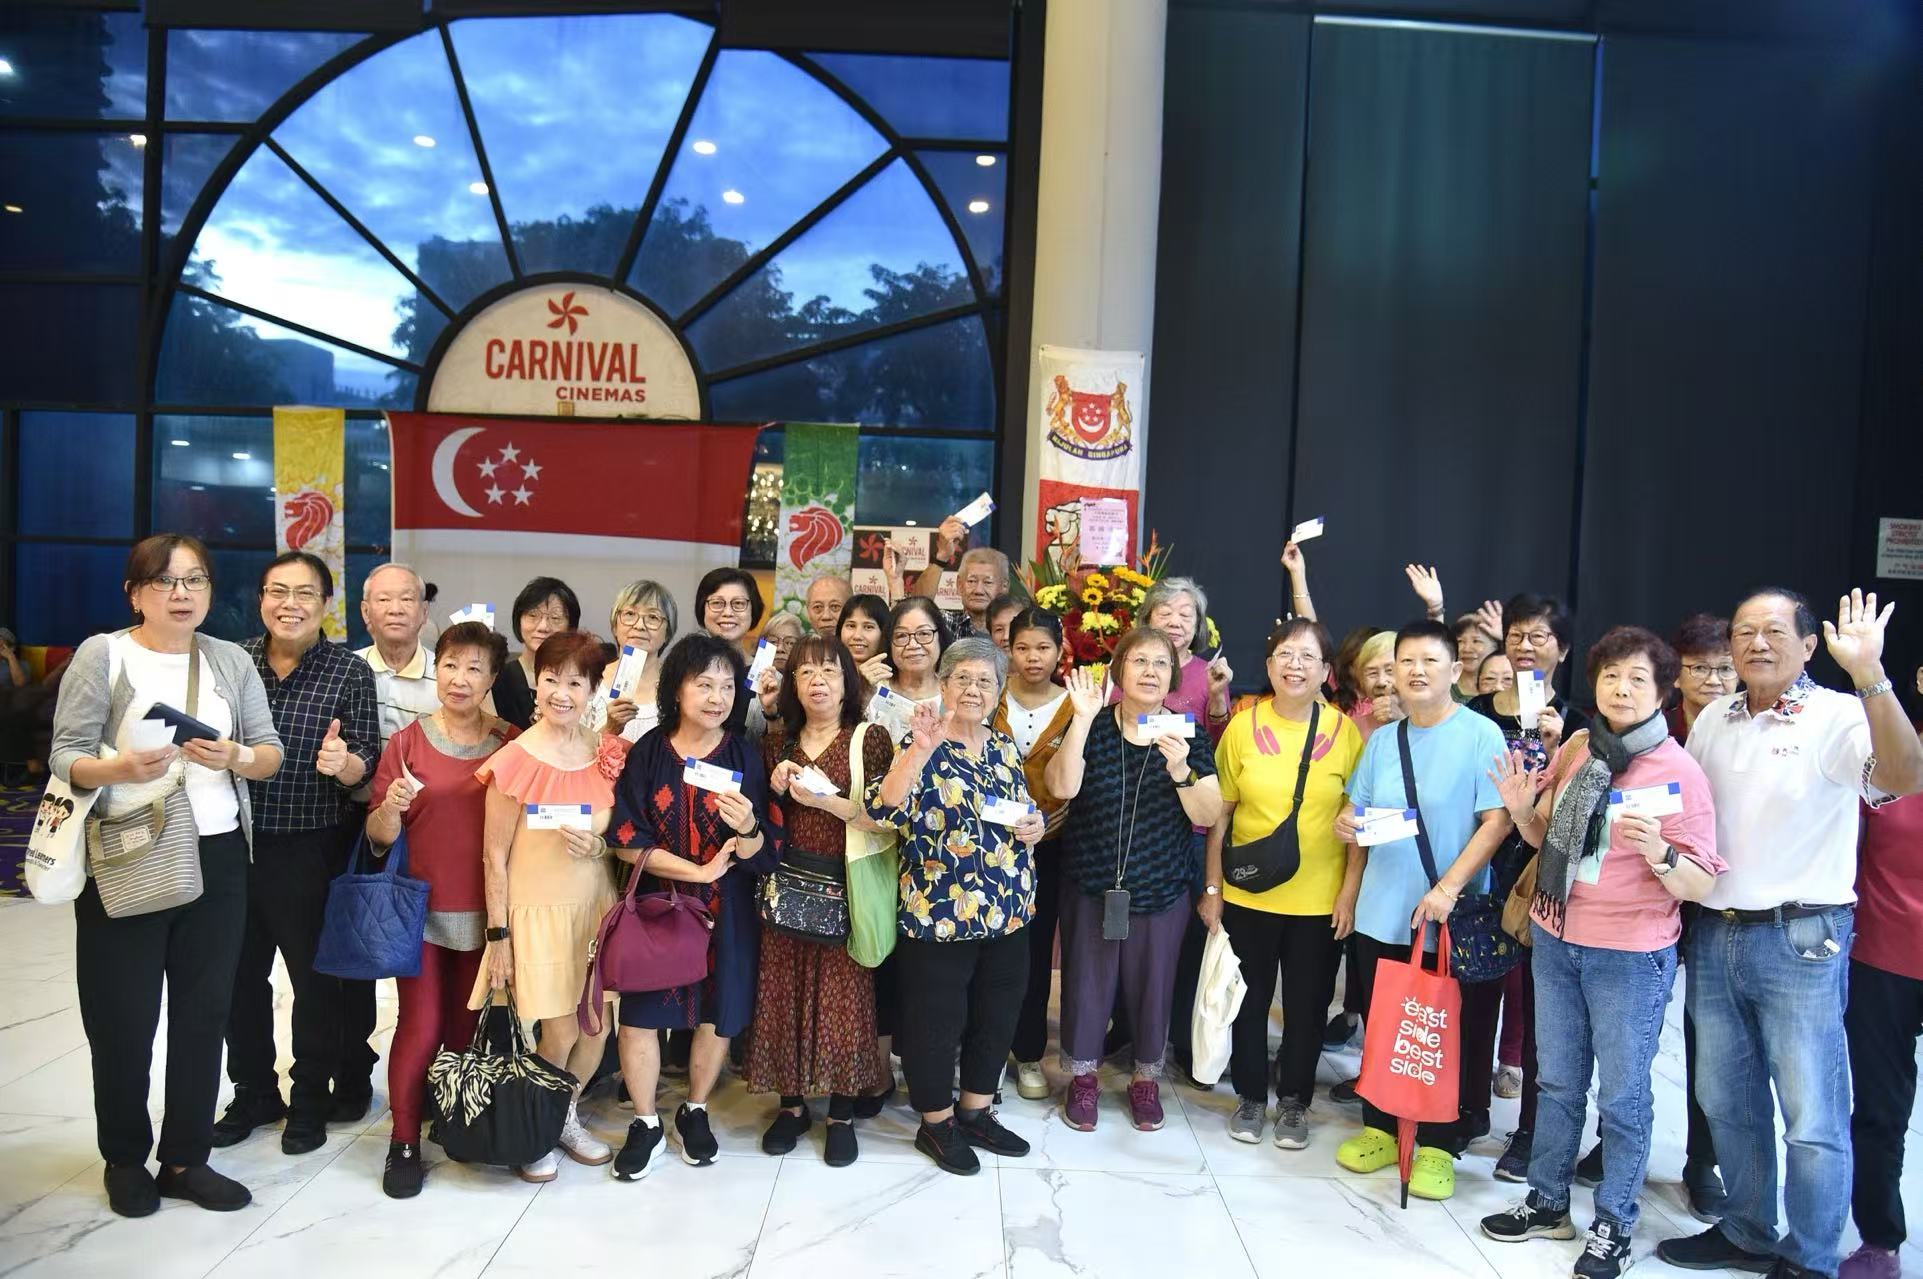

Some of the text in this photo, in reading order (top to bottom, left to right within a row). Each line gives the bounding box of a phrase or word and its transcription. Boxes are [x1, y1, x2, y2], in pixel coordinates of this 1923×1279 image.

[485, 338, 647, 384] CARNIVAL
[555, 386, 647, 403] CINEMAS
[1404, 1000, 1448, 1029] east
[1399, 1018, 1441, 1048] side
[1393, 1033, 1444, 1069] best
[1389, 1055, 1436, 1086] side
